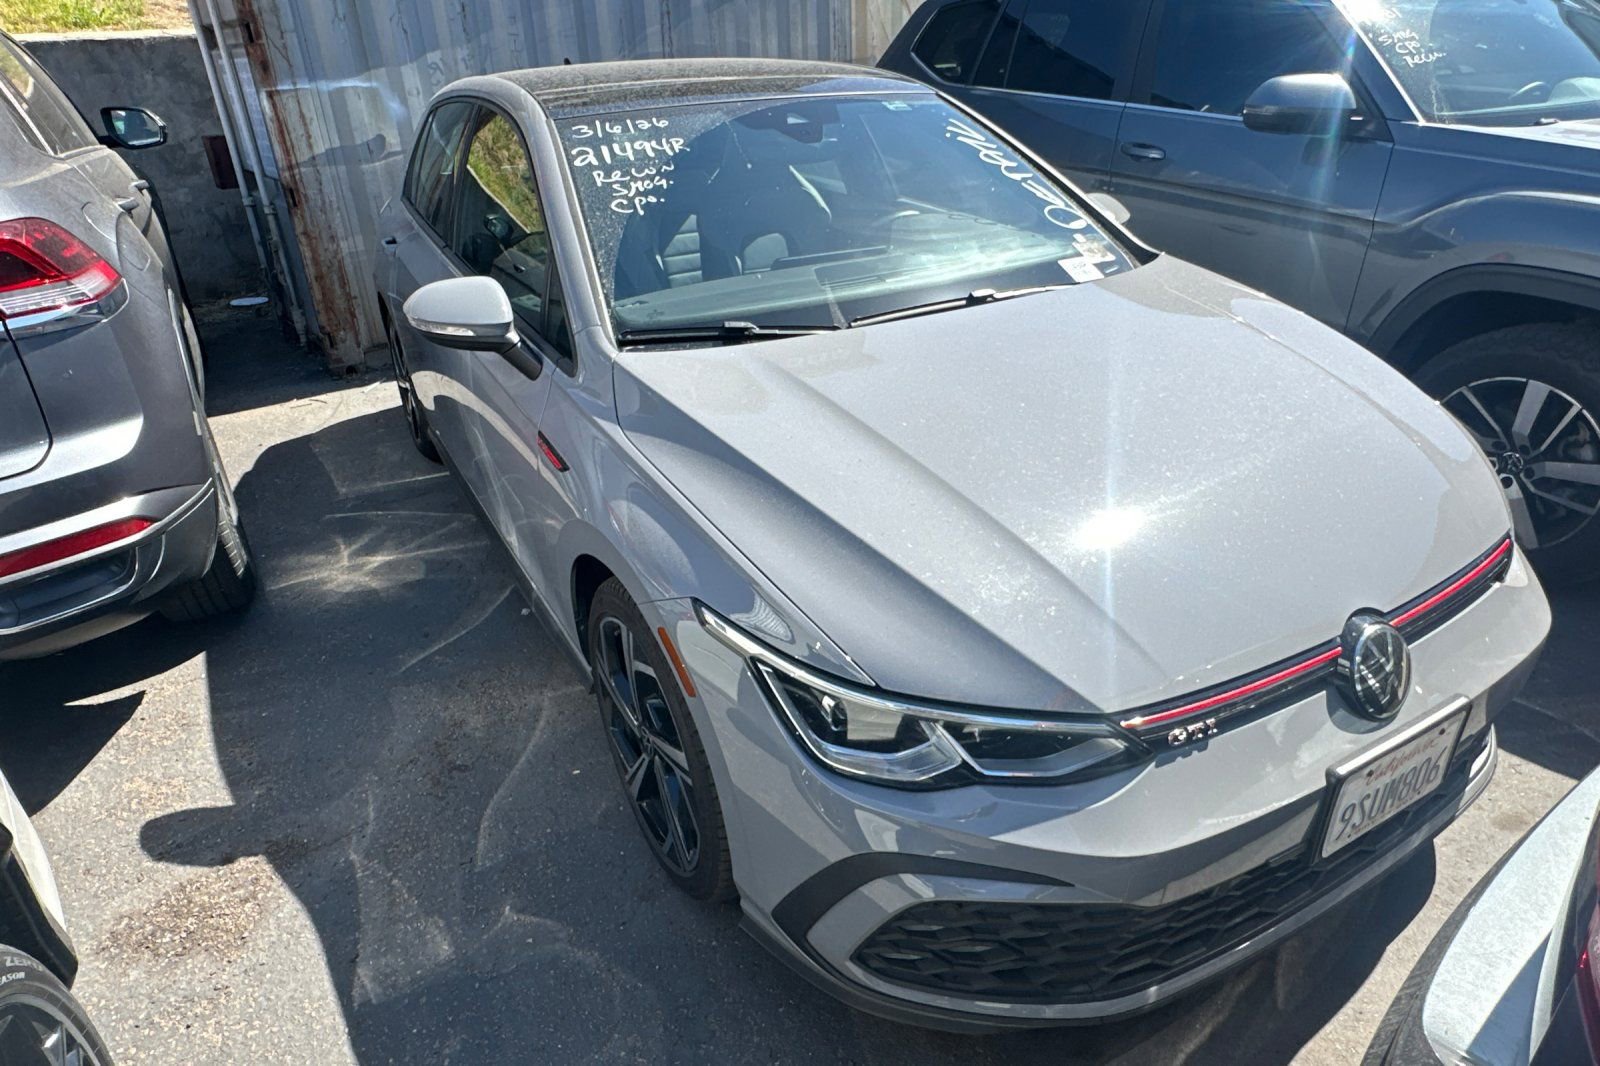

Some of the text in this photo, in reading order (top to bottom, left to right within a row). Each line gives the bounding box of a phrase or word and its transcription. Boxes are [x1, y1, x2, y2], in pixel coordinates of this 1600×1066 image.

[571, 117, 669, 139] 3/6/26
[571, 138, 690, 167] 21494R
[1167, 717, 1217, 746] GTI
[1335, 745, 1448, 841] 9SUM806
